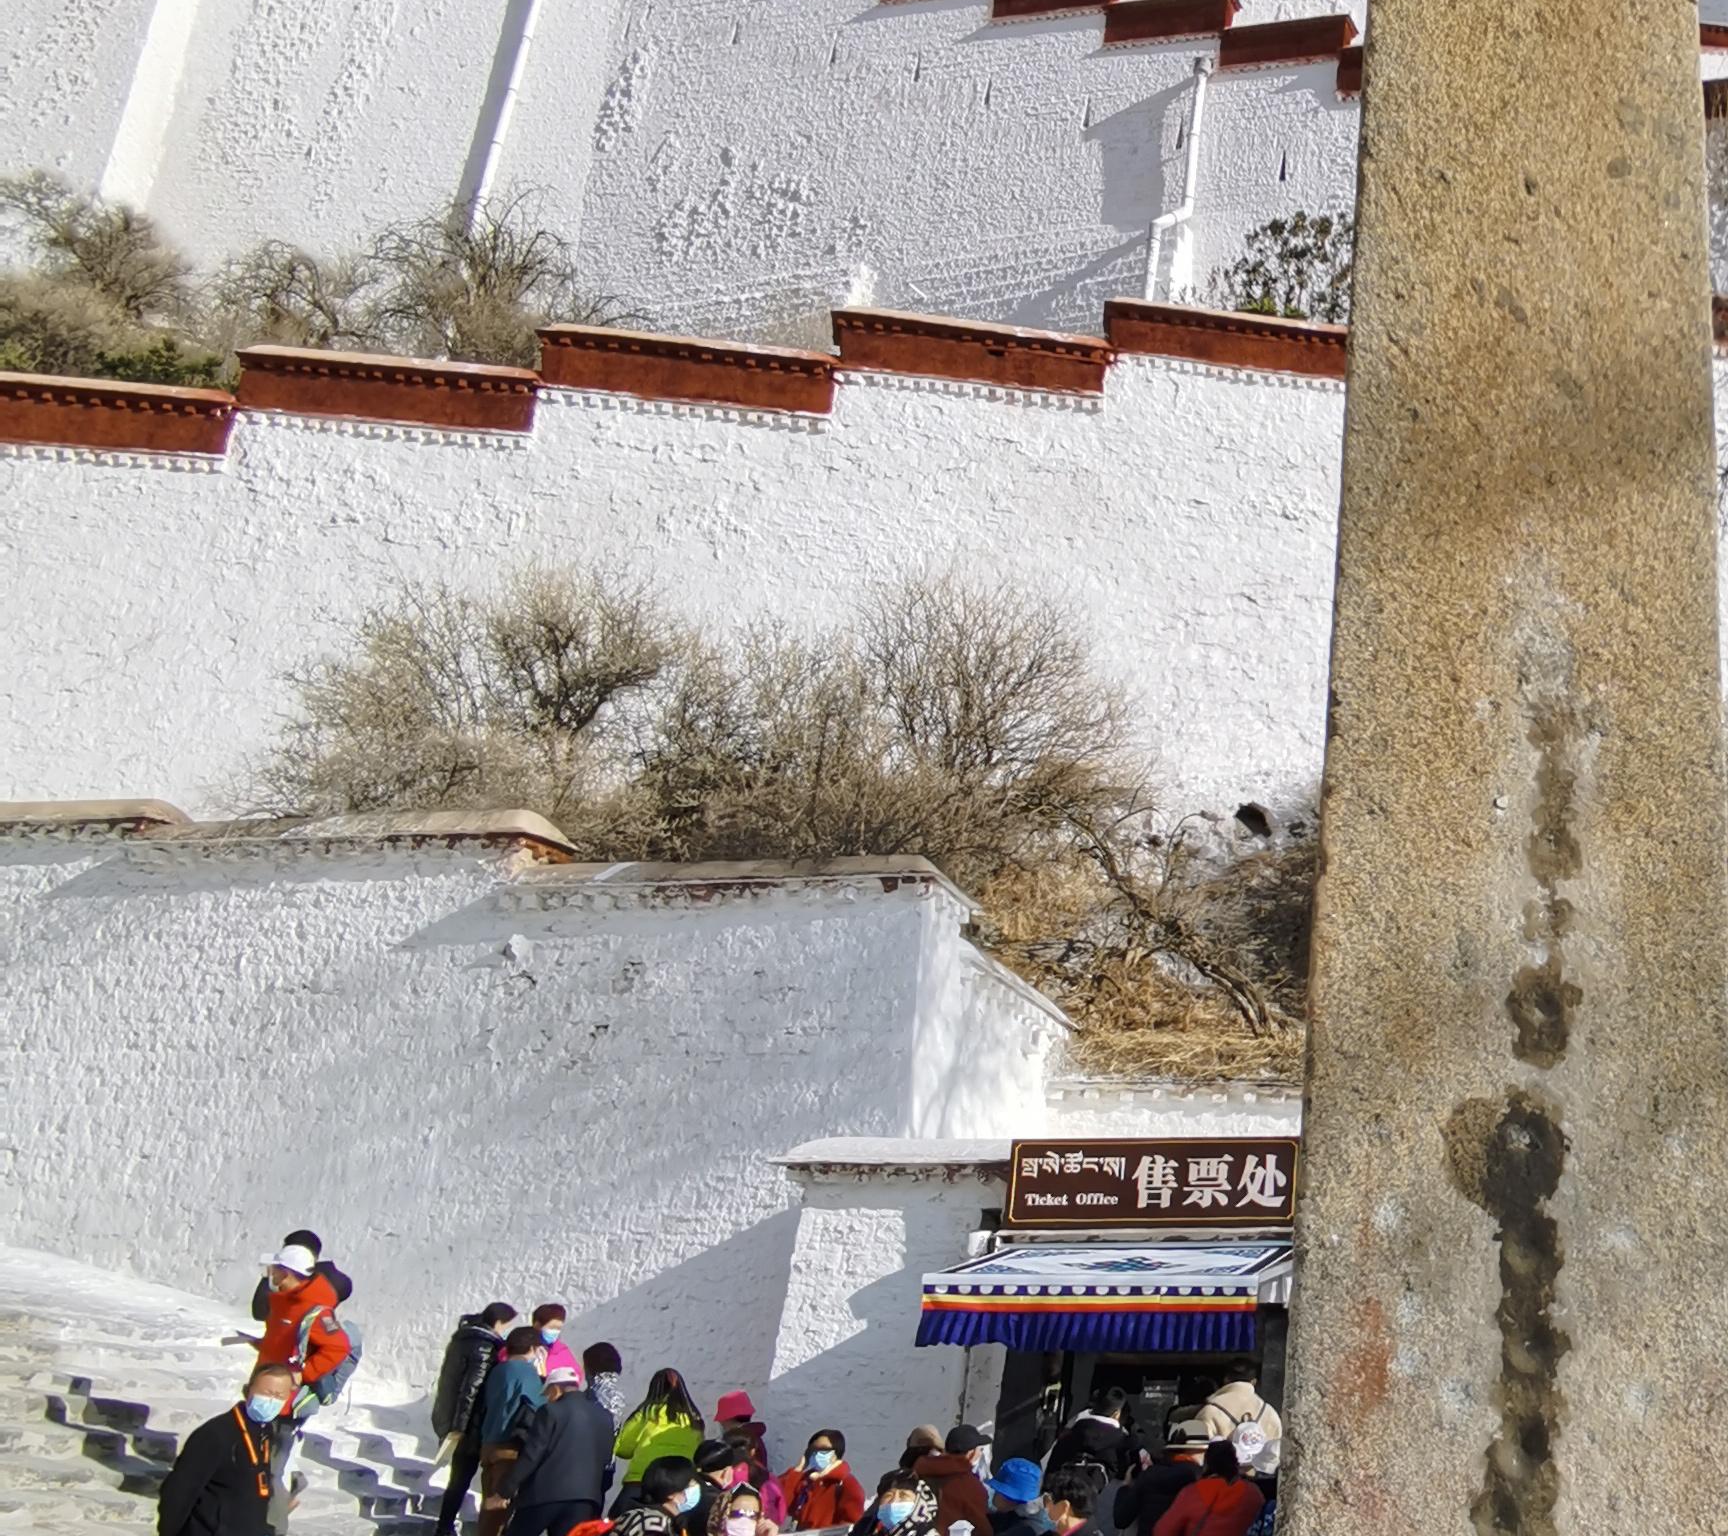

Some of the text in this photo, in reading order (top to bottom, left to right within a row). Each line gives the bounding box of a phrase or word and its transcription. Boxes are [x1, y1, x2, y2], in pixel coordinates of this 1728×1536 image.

[1132, 1154, 1286, 1208] 售票处
[1025, 1193, 1118, 1205] Ticket Office
